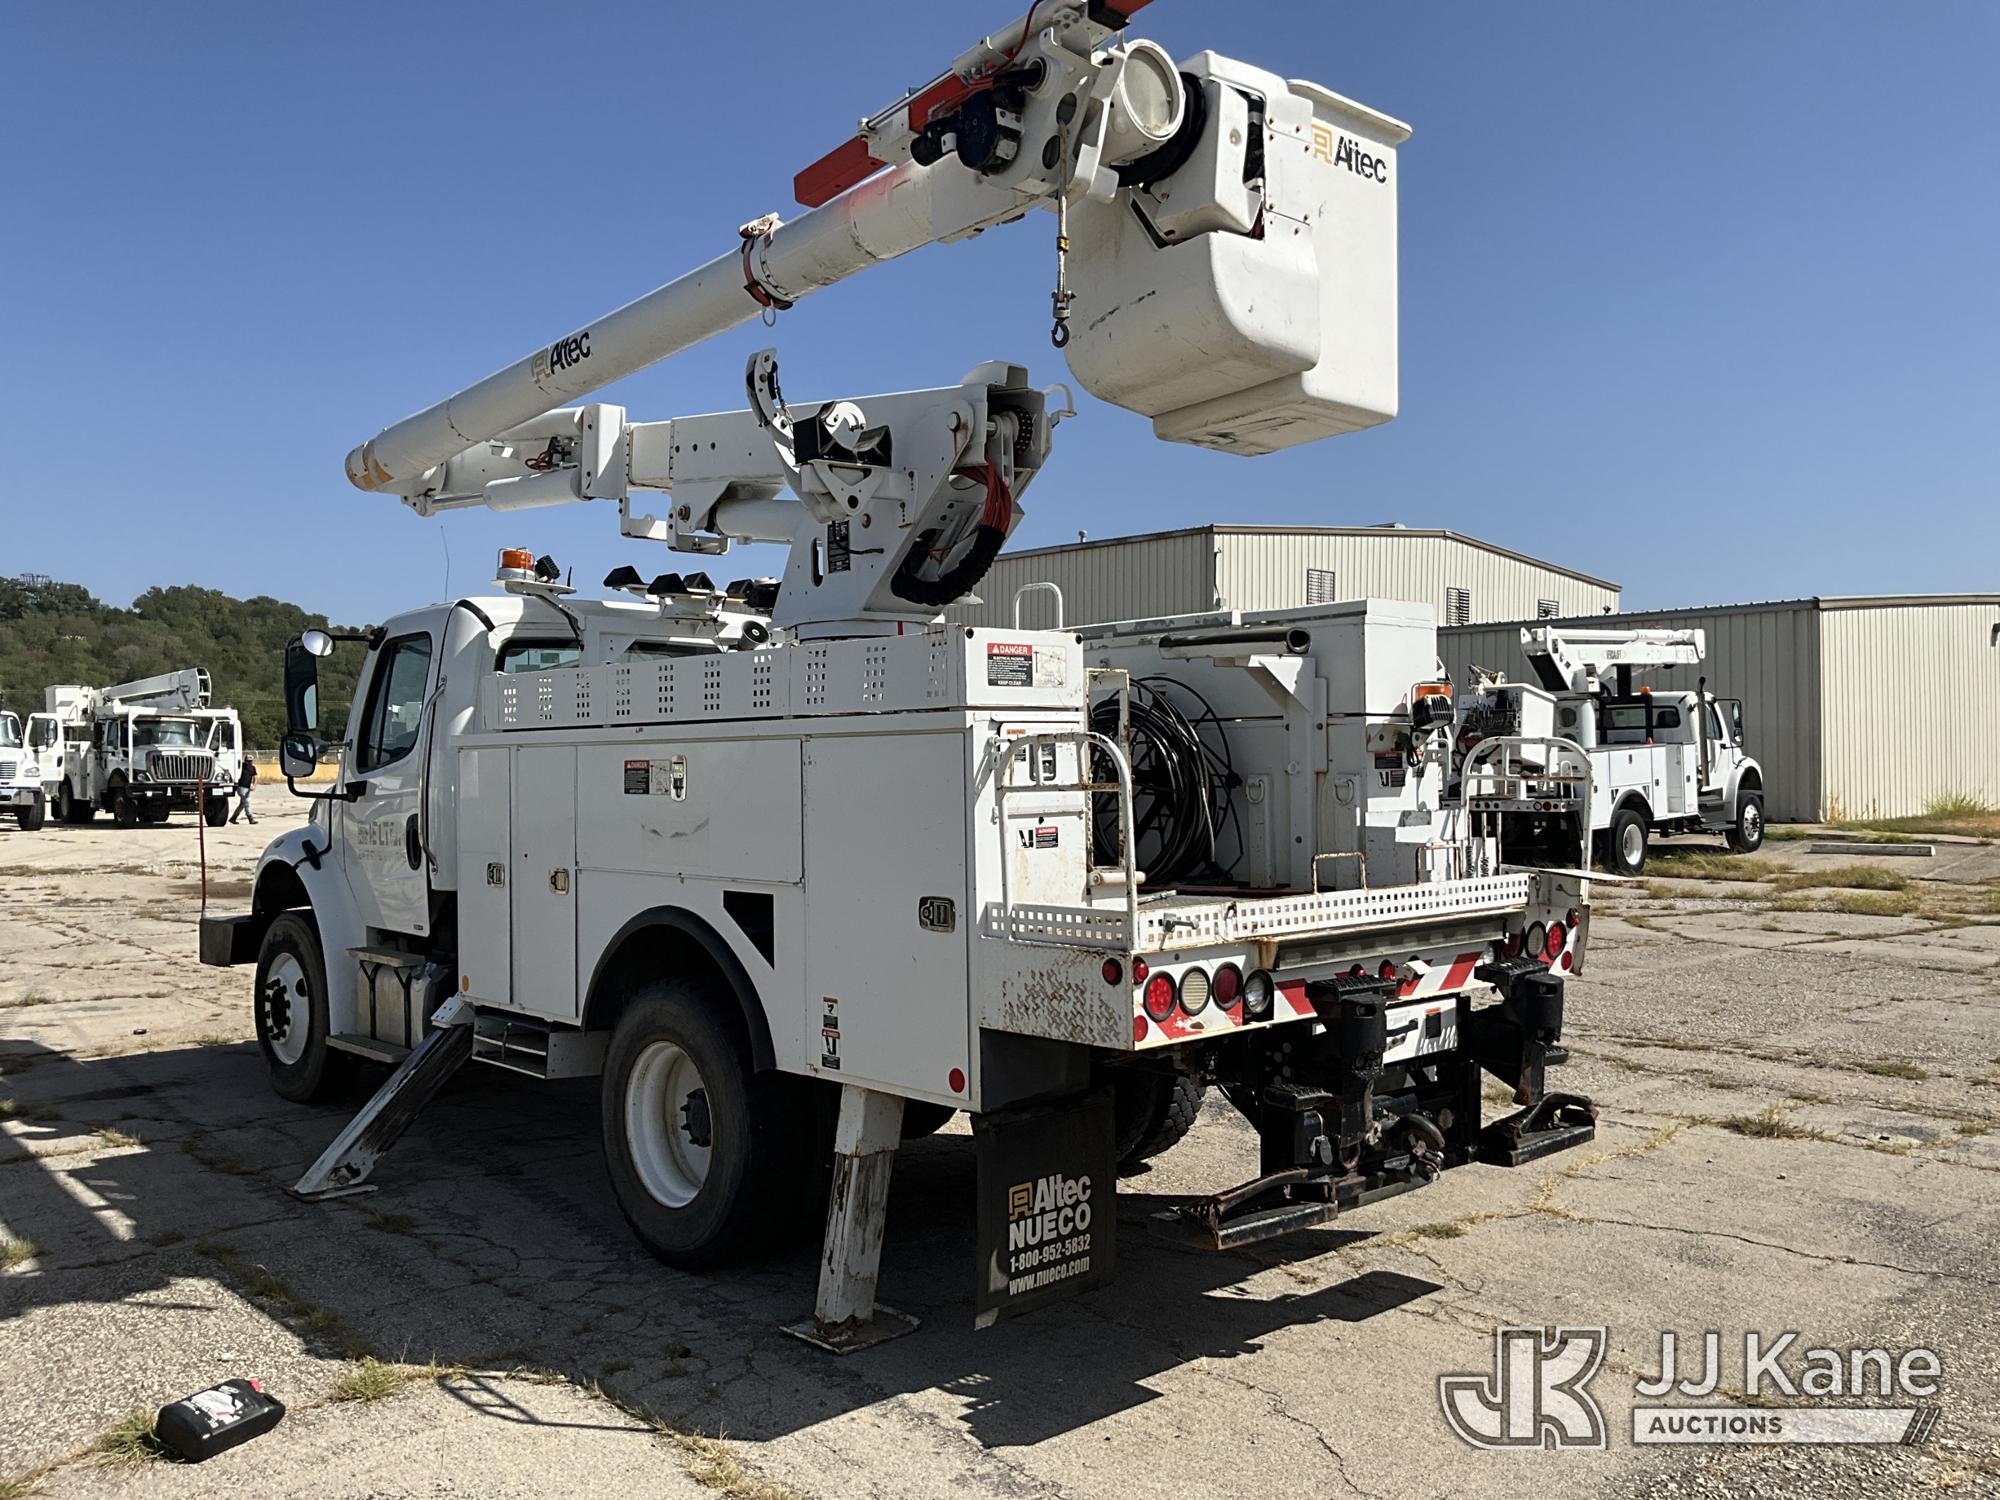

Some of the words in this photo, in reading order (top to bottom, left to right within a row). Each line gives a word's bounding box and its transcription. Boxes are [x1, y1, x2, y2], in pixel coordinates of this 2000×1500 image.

[1334, 136, 1387, 184] Altec
[550, 332, 591, 375] Altec
[999, 644, 1028, 655] DANGER
[1033, 1173, 1092, 1215] Altec
[1008, 1202, 1092, 1252] NUECO
[1009, 1233, 1091, 1273] 1-800-952-5832
[1008, 1256, 1090, 1296] www.nueco.com
